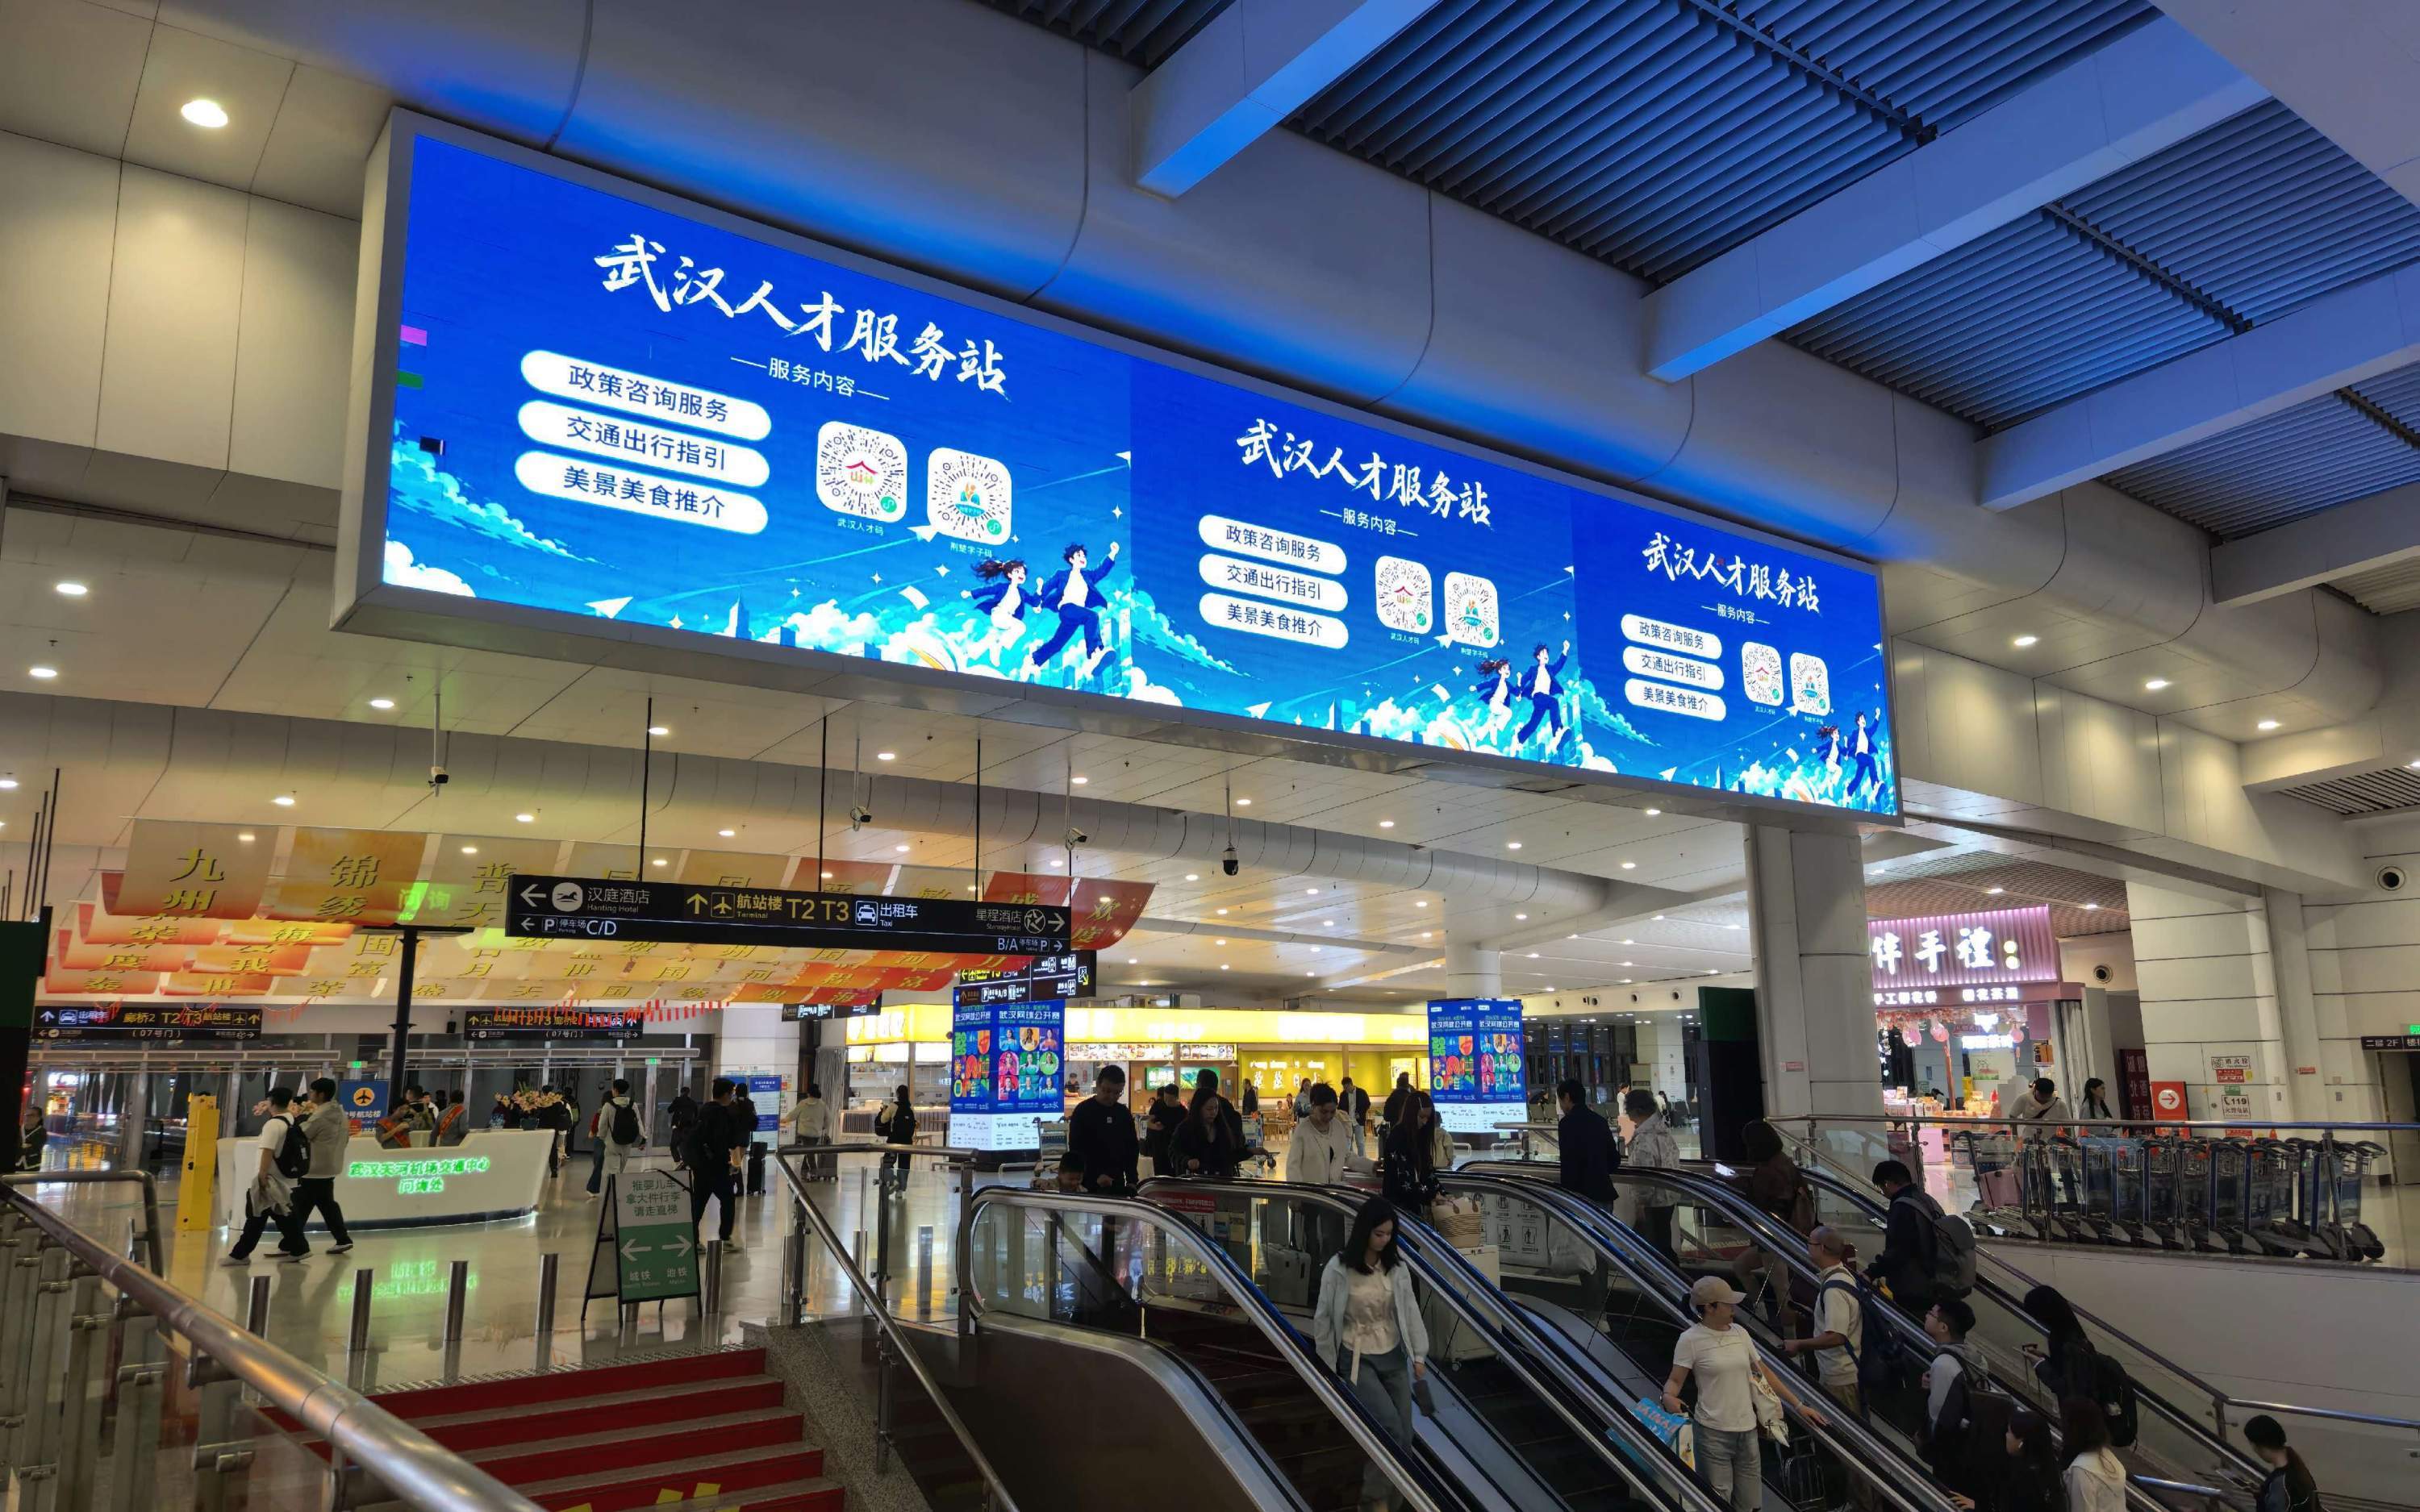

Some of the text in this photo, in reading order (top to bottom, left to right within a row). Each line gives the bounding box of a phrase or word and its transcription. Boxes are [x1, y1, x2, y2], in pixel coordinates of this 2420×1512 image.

[595, 233, 1012, 402] 武汉人才服务站
[569, 364, 728, 422] 政策咨询服务
[768, 357, 855, 397] 服务内容
[566, 416, 727, 471] 交通出行指引
[1237, 419, 1493, 529] 武汉人才服务站
[563, 466, 725, 519] 美景美食推介
[837, 517, 884, 535] 武汉人才码
[1342, 508, 1396, 535] 服务内容
[949, 541, 992, 558] 荆楚学子码
[1226, 525, 1321, 562] 政策咨询服务
[1226, 564, 1321, 600] 交通出行指引
[1642, 532, 1822, 618] 武汉人才服务站
[1227, 602, 1322, 637] 美景美食推介
[1717, 603, 1755, 624] 服务内容
[1639, 621, 1704, 649] 政策咨询服务
[1642, 654, 1705, 681] 交通出行指引
[1643, 686, 1708, 712] 美景美食推介
[587, 886, 1021, 923] 汉庭酒店 航站楼 T2 T3 出租车 星程酒店
[587, 904, 616, 913] Hanting
[586, 919, 617, 936] C/D
[998, 937, 1018, 951] B/A
[161, 1012, 179, 1023] T2
[999, 1010, 1060, 1020] 武汉网球公开赛
